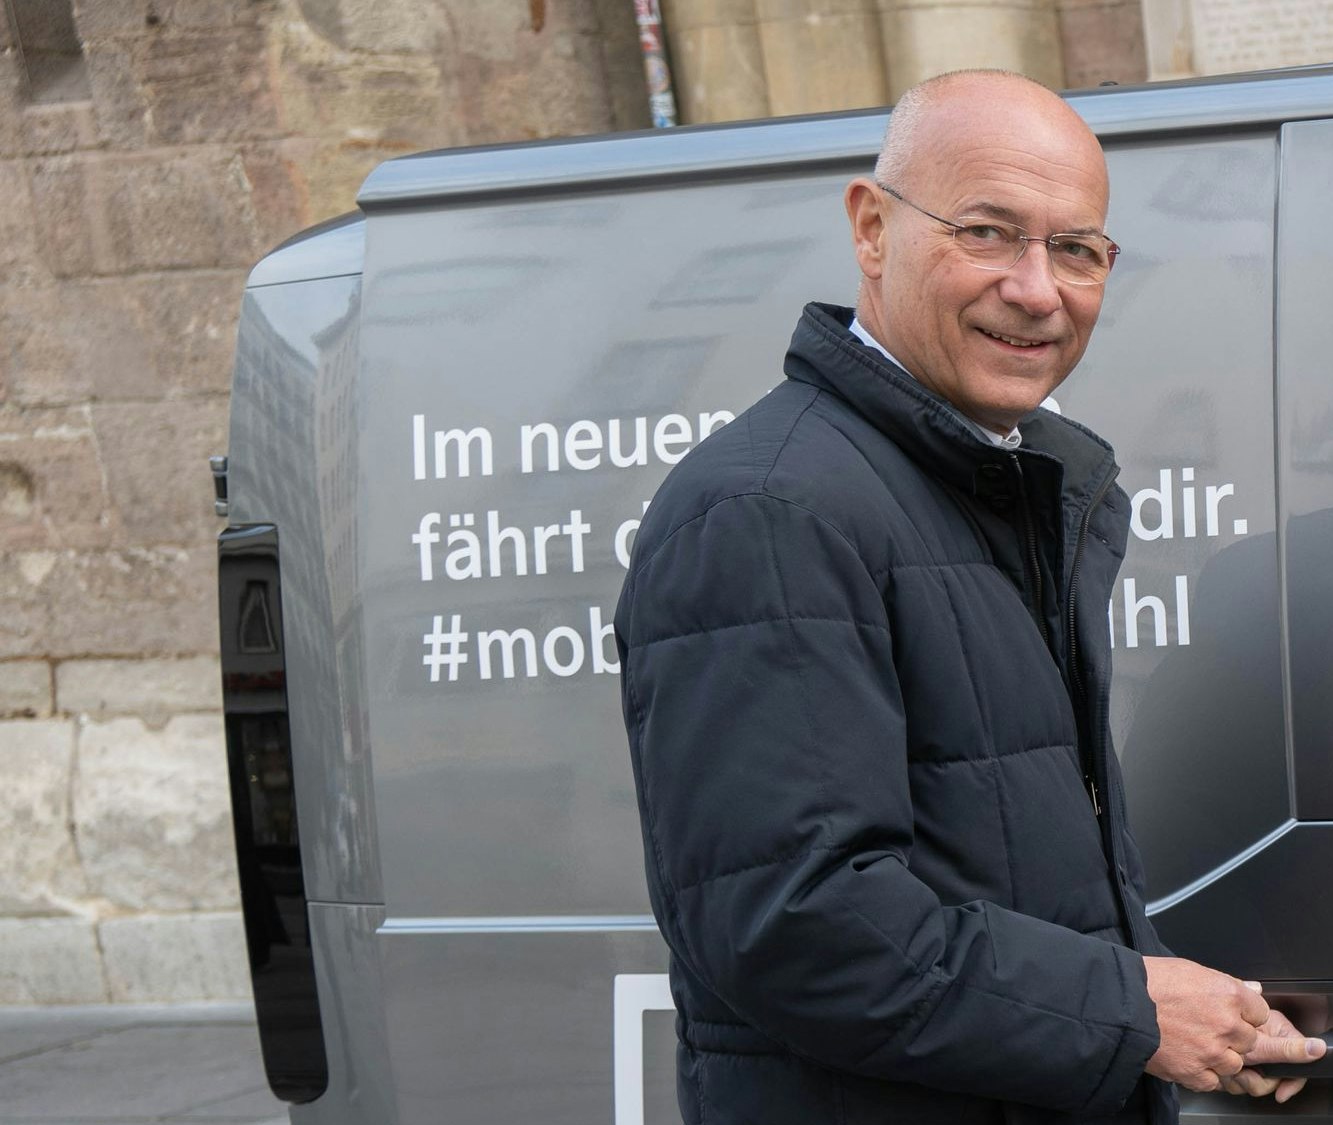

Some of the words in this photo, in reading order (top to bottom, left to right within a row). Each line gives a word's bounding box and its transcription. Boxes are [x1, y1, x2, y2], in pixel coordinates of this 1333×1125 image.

[413, 414, 493, 480] Im
[411, 509, 591, 581] fährt
[1129, 467, 1248, 541] dir.
